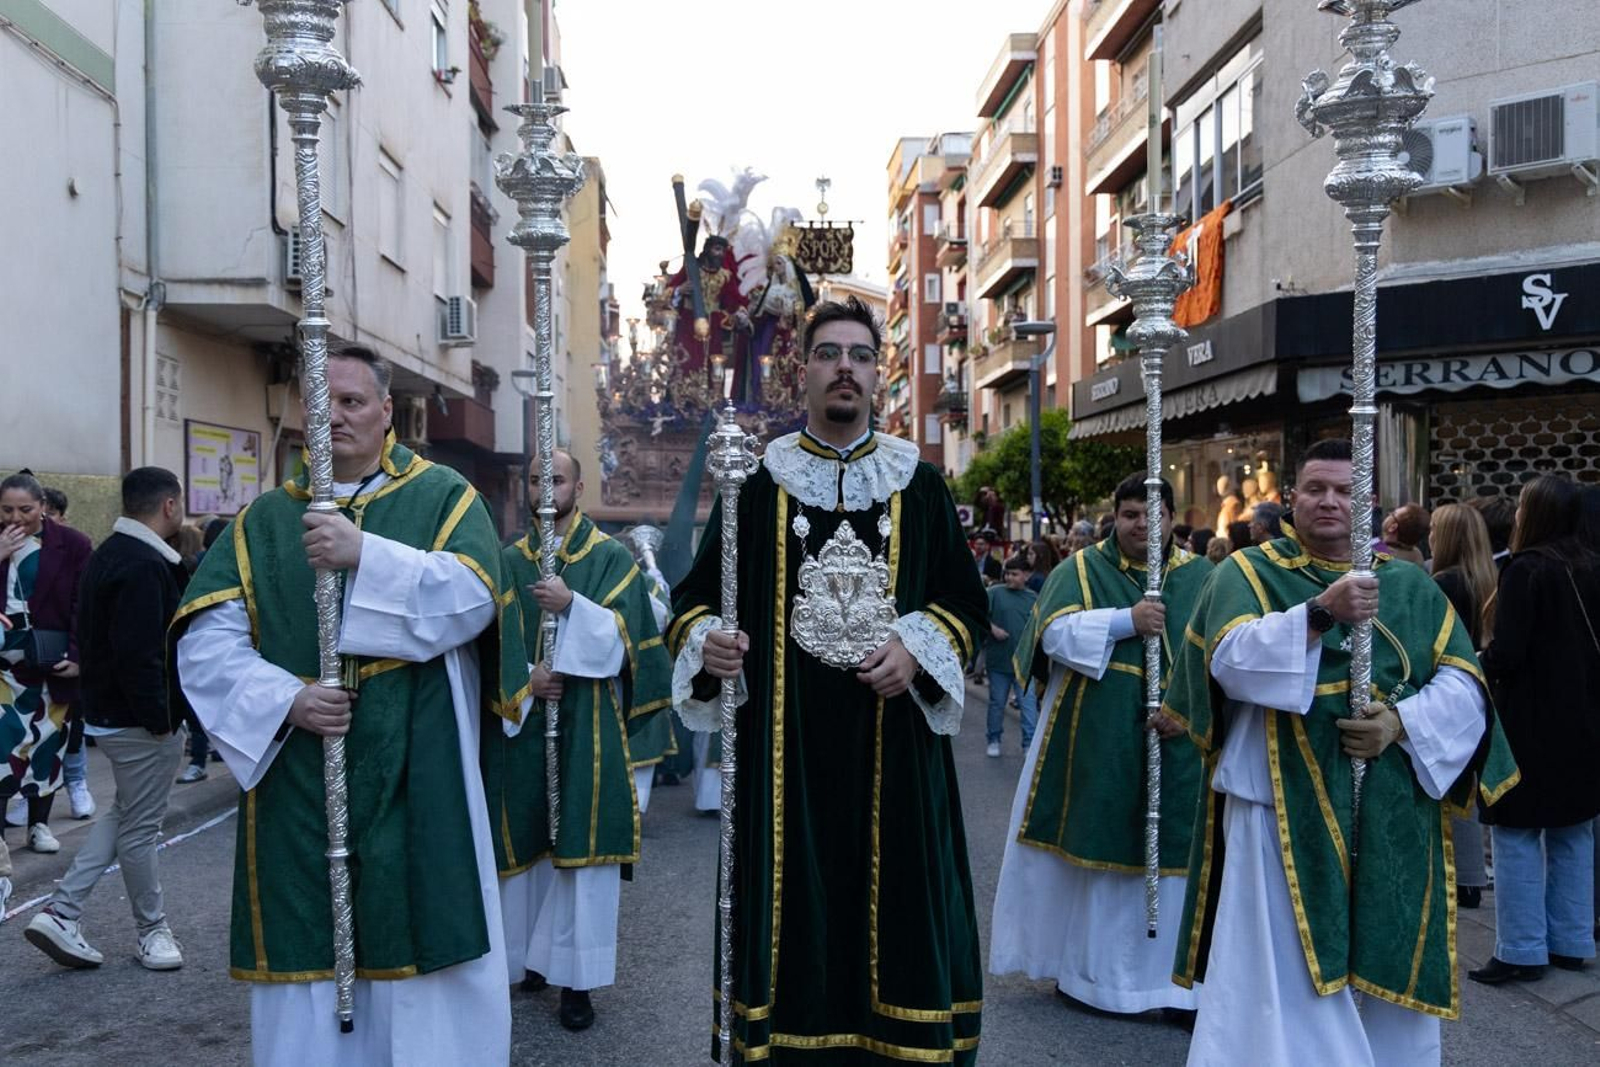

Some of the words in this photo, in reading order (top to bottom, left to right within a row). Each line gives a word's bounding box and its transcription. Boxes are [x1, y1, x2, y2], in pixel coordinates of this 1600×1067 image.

[801, 240, 841, 258] SPQR
[1522, 273, 1569, 330] SV
[1187, 340, 1214, 367] VERA
